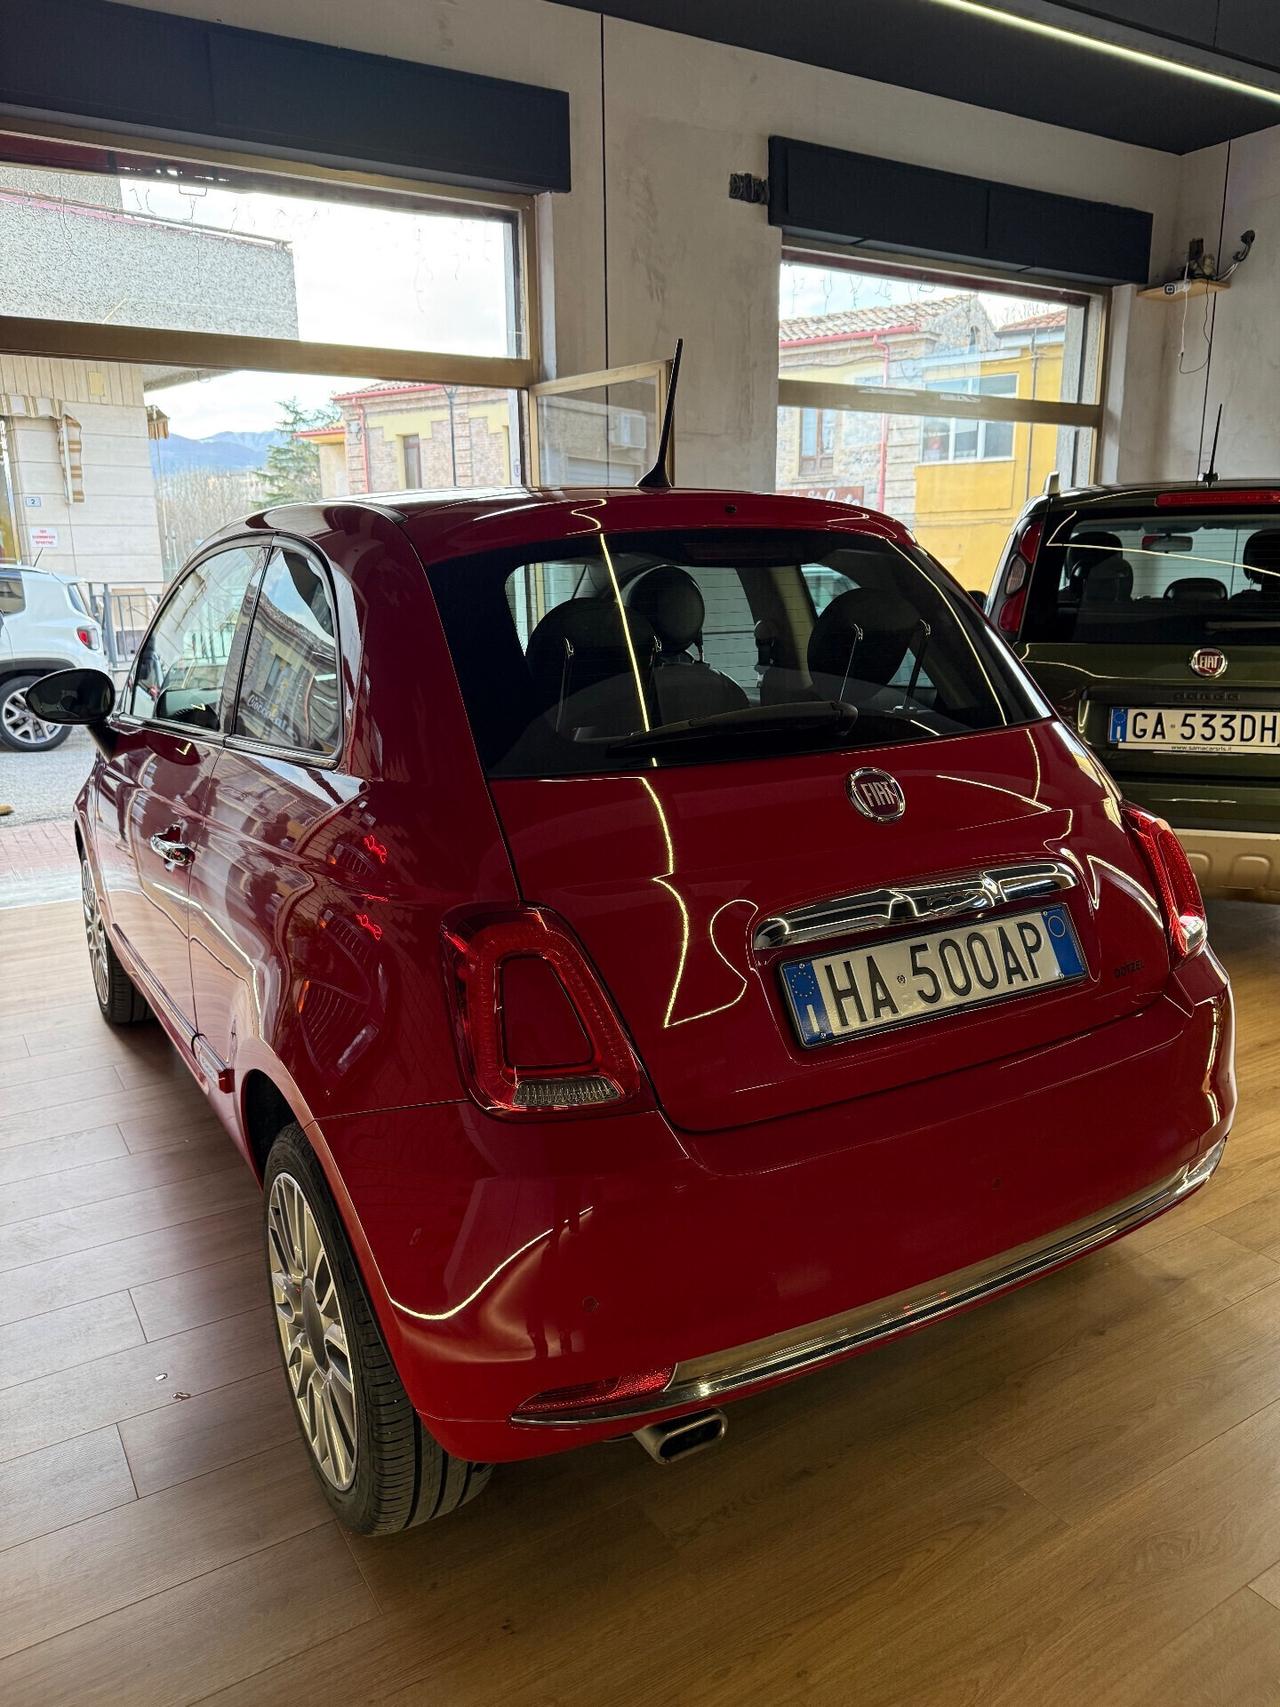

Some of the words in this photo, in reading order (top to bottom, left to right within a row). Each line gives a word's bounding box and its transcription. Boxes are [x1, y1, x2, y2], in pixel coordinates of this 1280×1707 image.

[1199, 655, 1219, 669] FIAT
[1132, 712, 1167, 740] GA
[1180, 713, 1278, 744] 533DH
[860, 781, 896, 807] FIAT
[823, 954, 899, 1028] HA
[910, 921, 1043, 1004] 500AP
